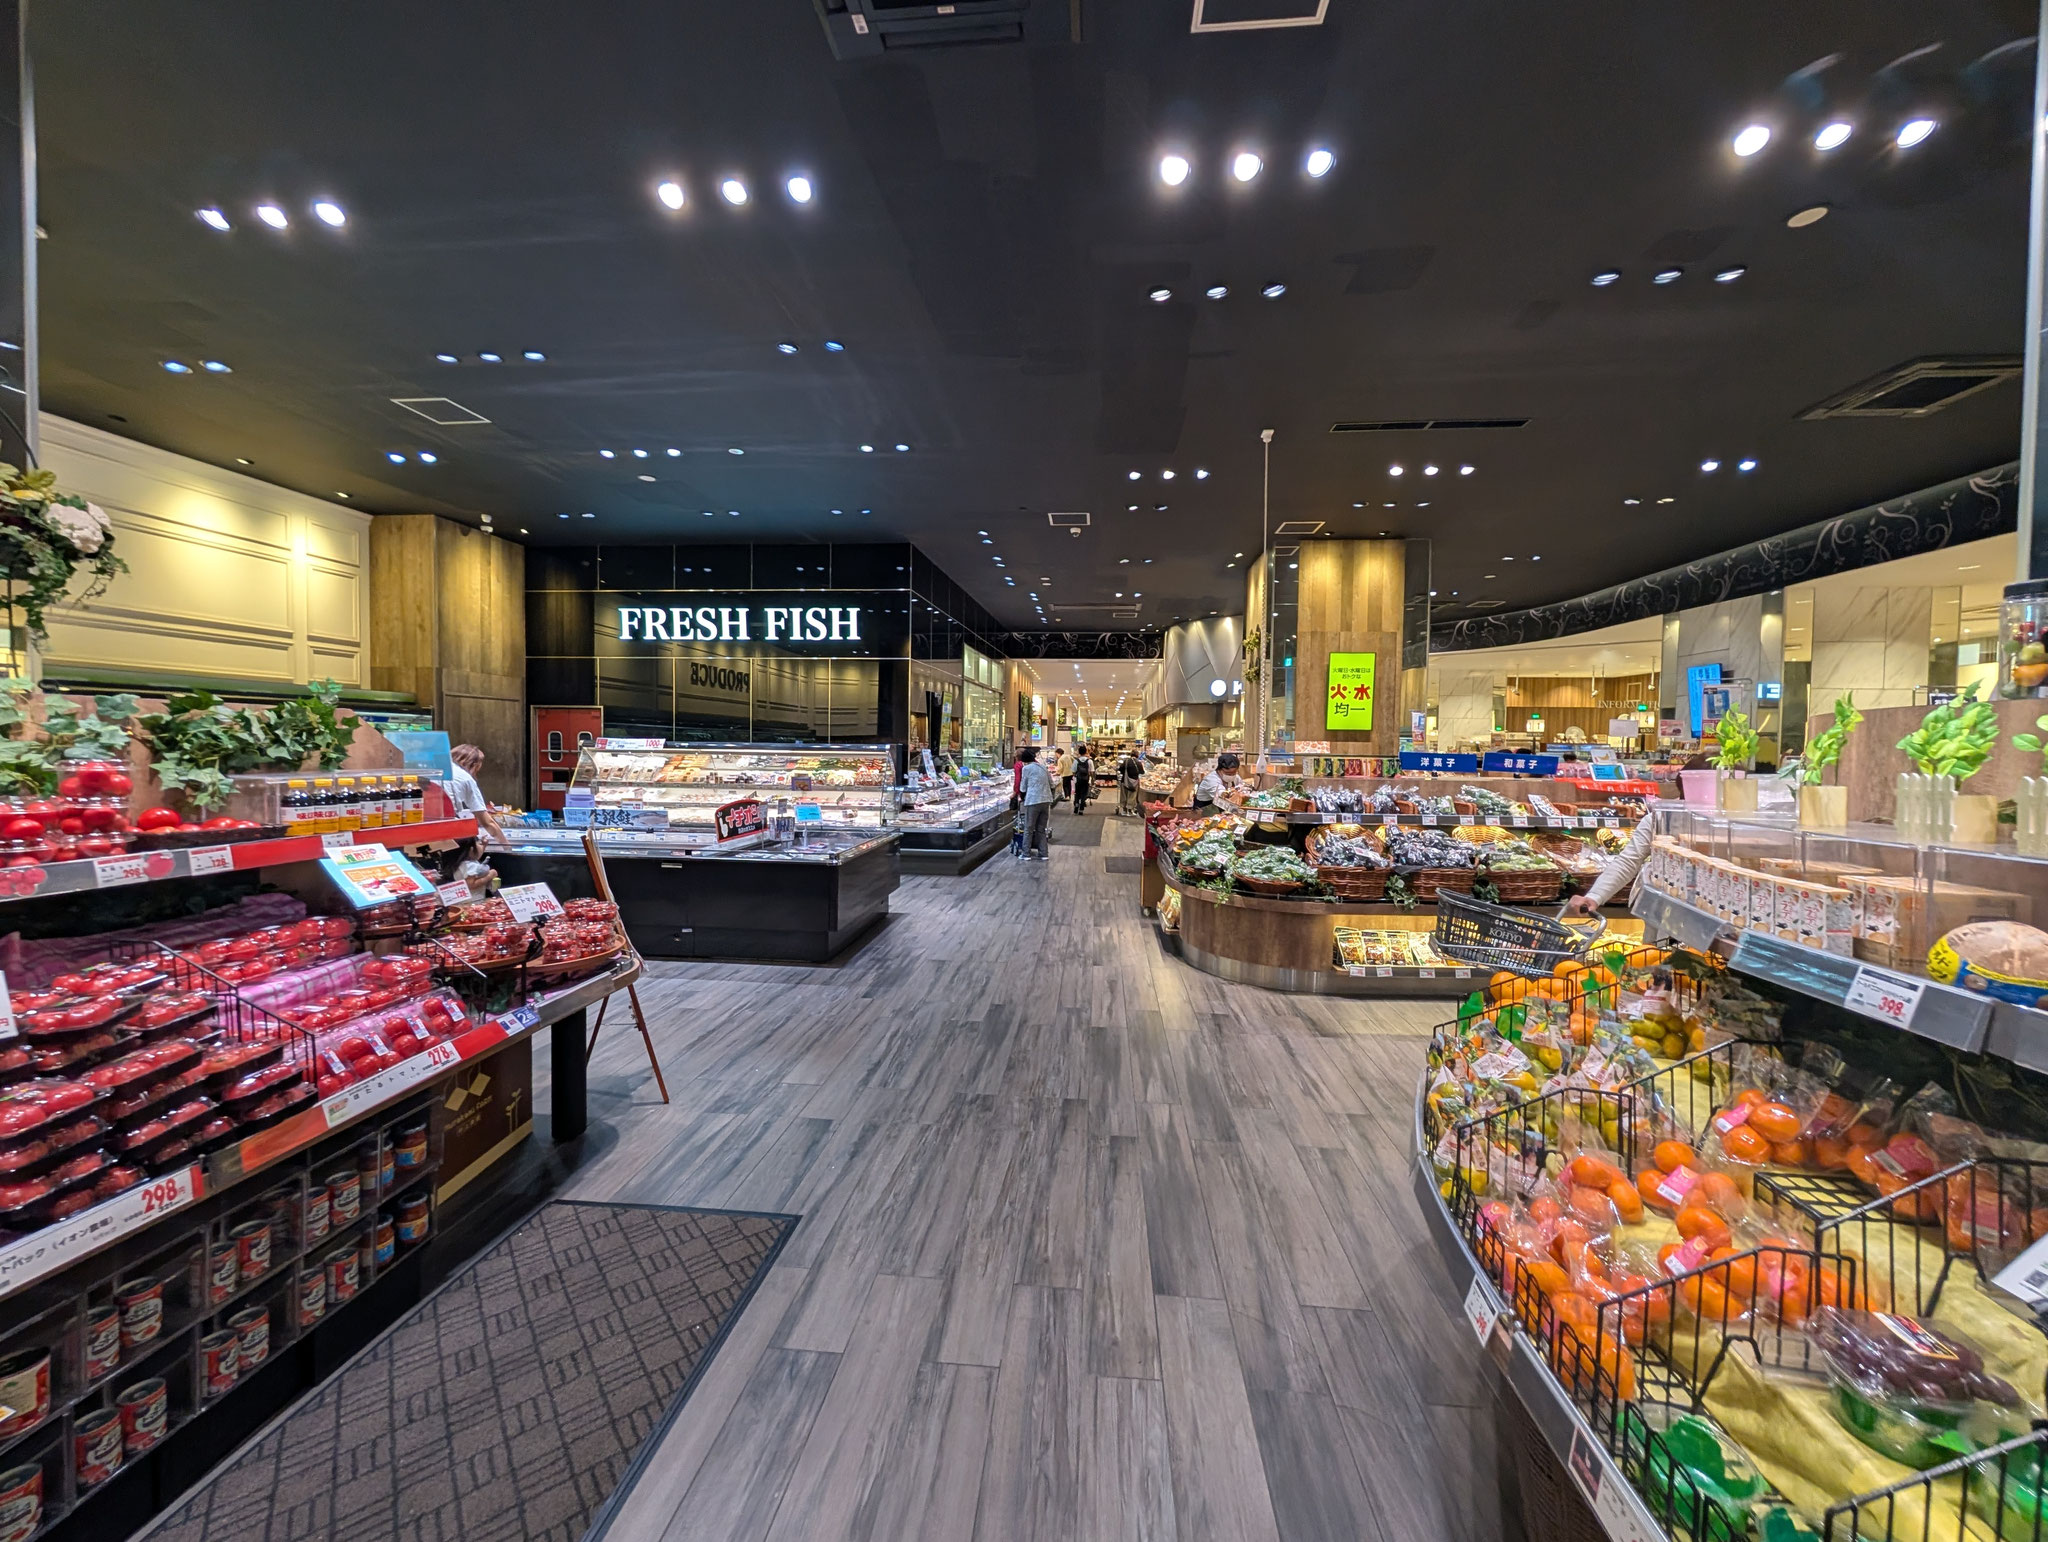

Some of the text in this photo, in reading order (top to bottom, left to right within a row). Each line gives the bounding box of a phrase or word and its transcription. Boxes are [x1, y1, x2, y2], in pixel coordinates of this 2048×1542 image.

[618, 607, 861, 641] FRESH FISH
[1330, 683, 1371, 700] 火・水
[1334, 702, 1366, 717] 均一
[1420, 757, 1456, 768] 洋菓子
[1503, 758, 1538, 770] 和菓子
[1489, 927, 1523, 943] KOHYO
